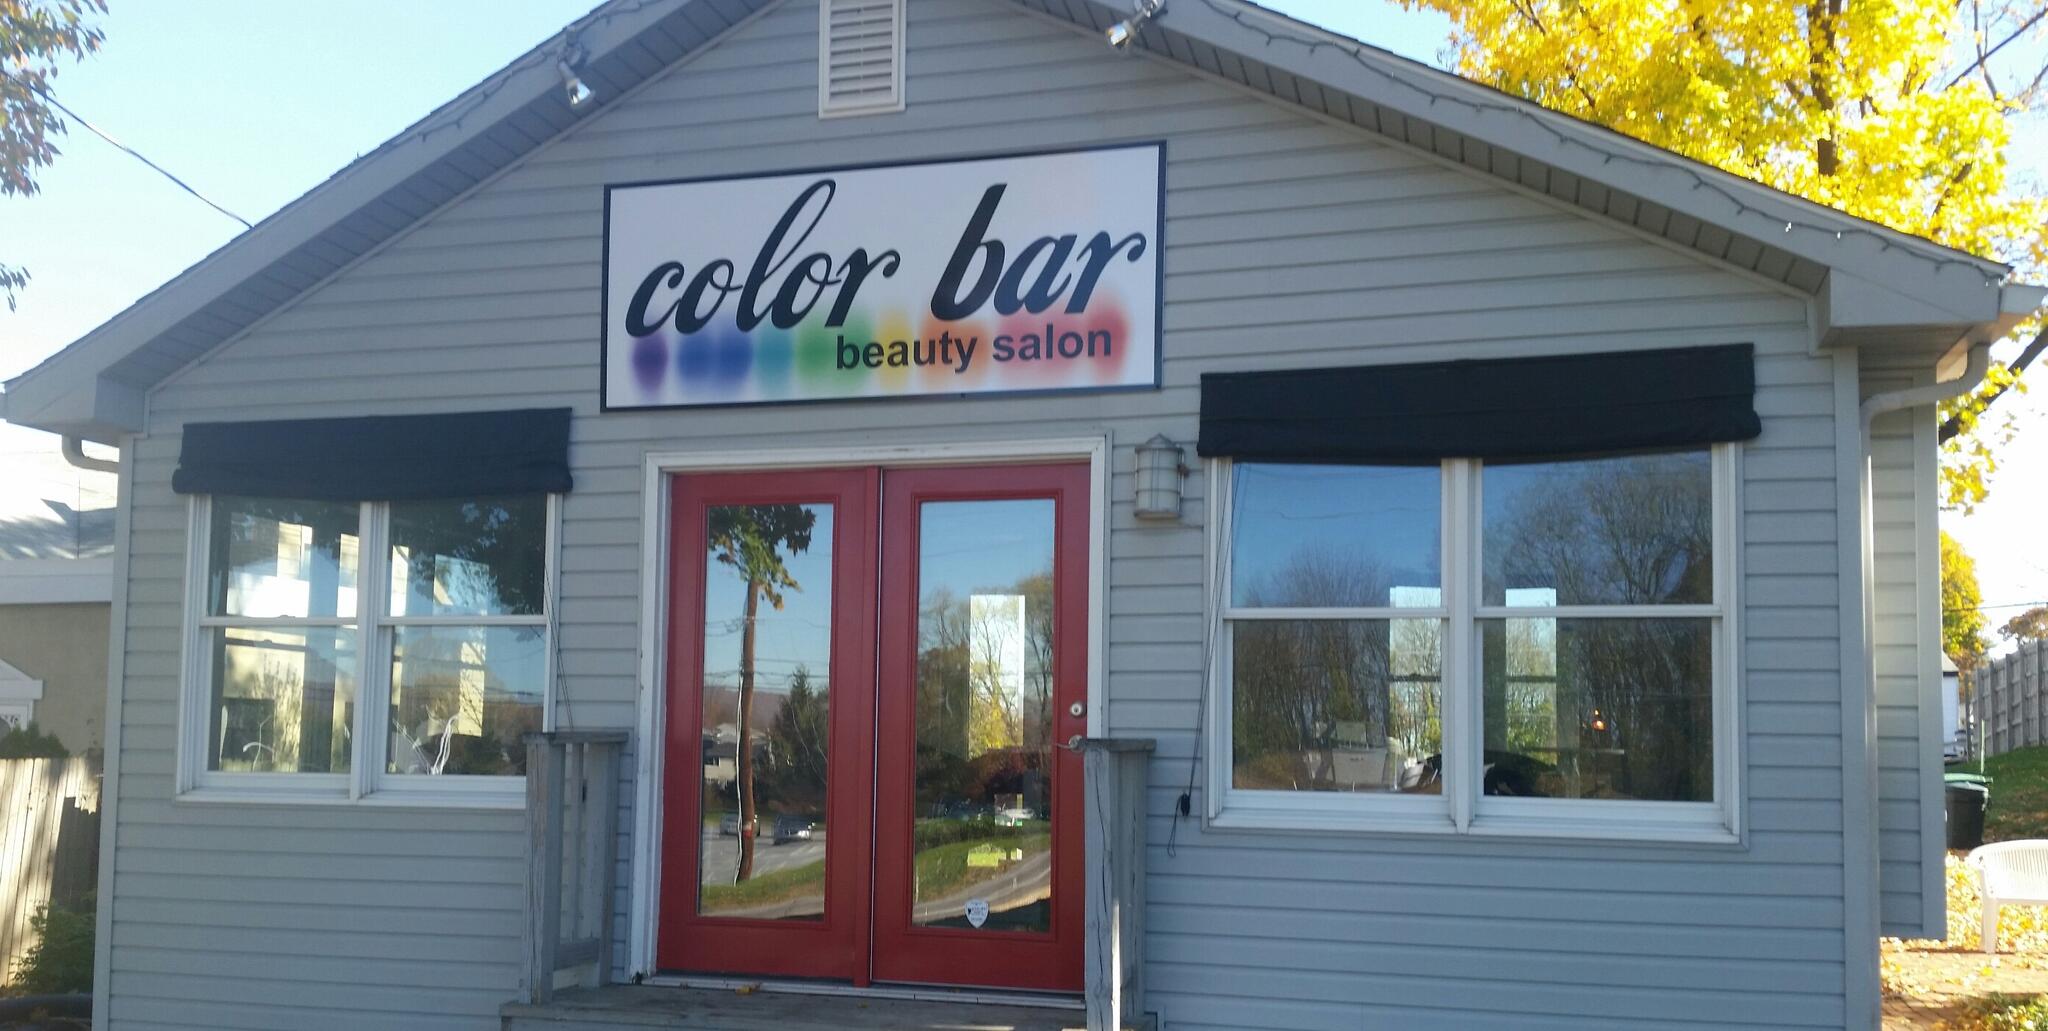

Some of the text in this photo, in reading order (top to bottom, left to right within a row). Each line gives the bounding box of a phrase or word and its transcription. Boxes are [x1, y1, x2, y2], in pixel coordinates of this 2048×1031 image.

[625, 179, 1147, 337] color bar
[835, 323, 1112, 374] beauty salon
